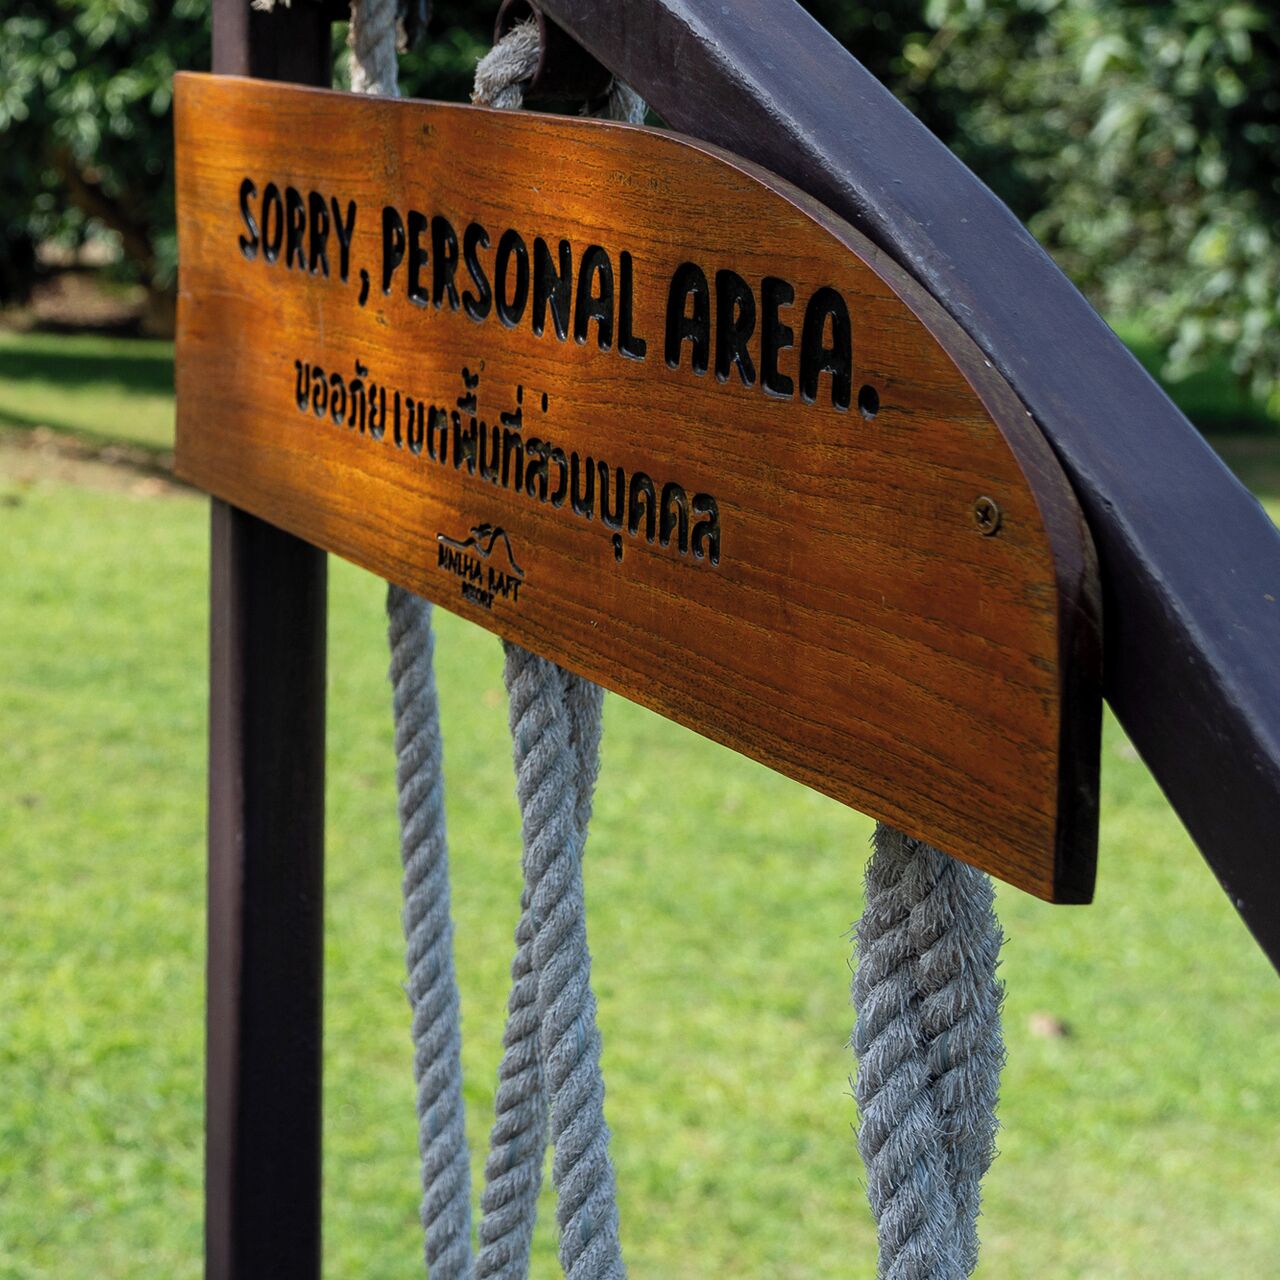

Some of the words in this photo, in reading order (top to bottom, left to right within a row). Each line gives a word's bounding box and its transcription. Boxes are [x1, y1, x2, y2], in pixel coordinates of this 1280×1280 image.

[238, 176, 371, 308] SORRY,
[381, 205, 648, 361] PERSONAL
[664, 261, 882, 420] AREA.
